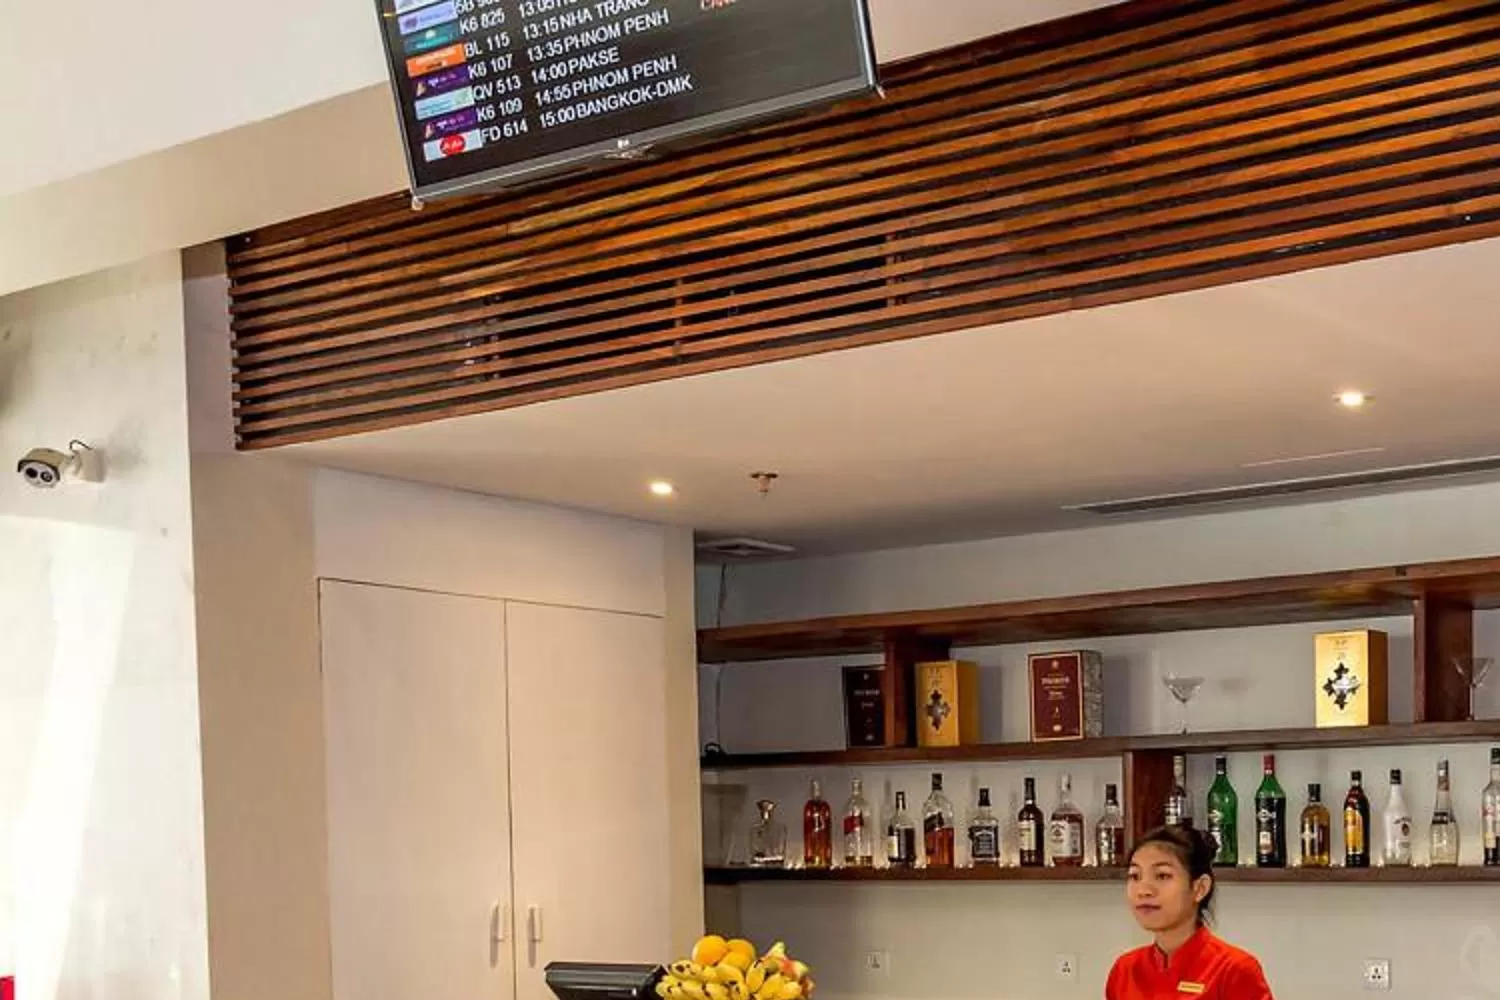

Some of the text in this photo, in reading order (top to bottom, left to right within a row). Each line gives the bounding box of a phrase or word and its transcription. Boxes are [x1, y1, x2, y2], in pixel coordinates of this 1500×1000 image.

[460, 17, 479, 35] K6
[464, 42, 483, 57] BL
[487, 32, 511, 51] 115
[522, 17, 559, 40] 13:15
[560, 8, 593, 31] NHA
[467, 8, 670, 80] K6 107 13:35 PHNOM PENH
[473, 82, 493, 101] QV
[497, 75, 522, 94] 513
[531, 62, 567, 84] 14:00
[568, 47, 621, 75] PAKSE
[476, 54, 678, 123] K6 109 14:55 PHNOM PENH
[482, 74, 694, 144] FD 614 15:00 BANGKOK-DMK
